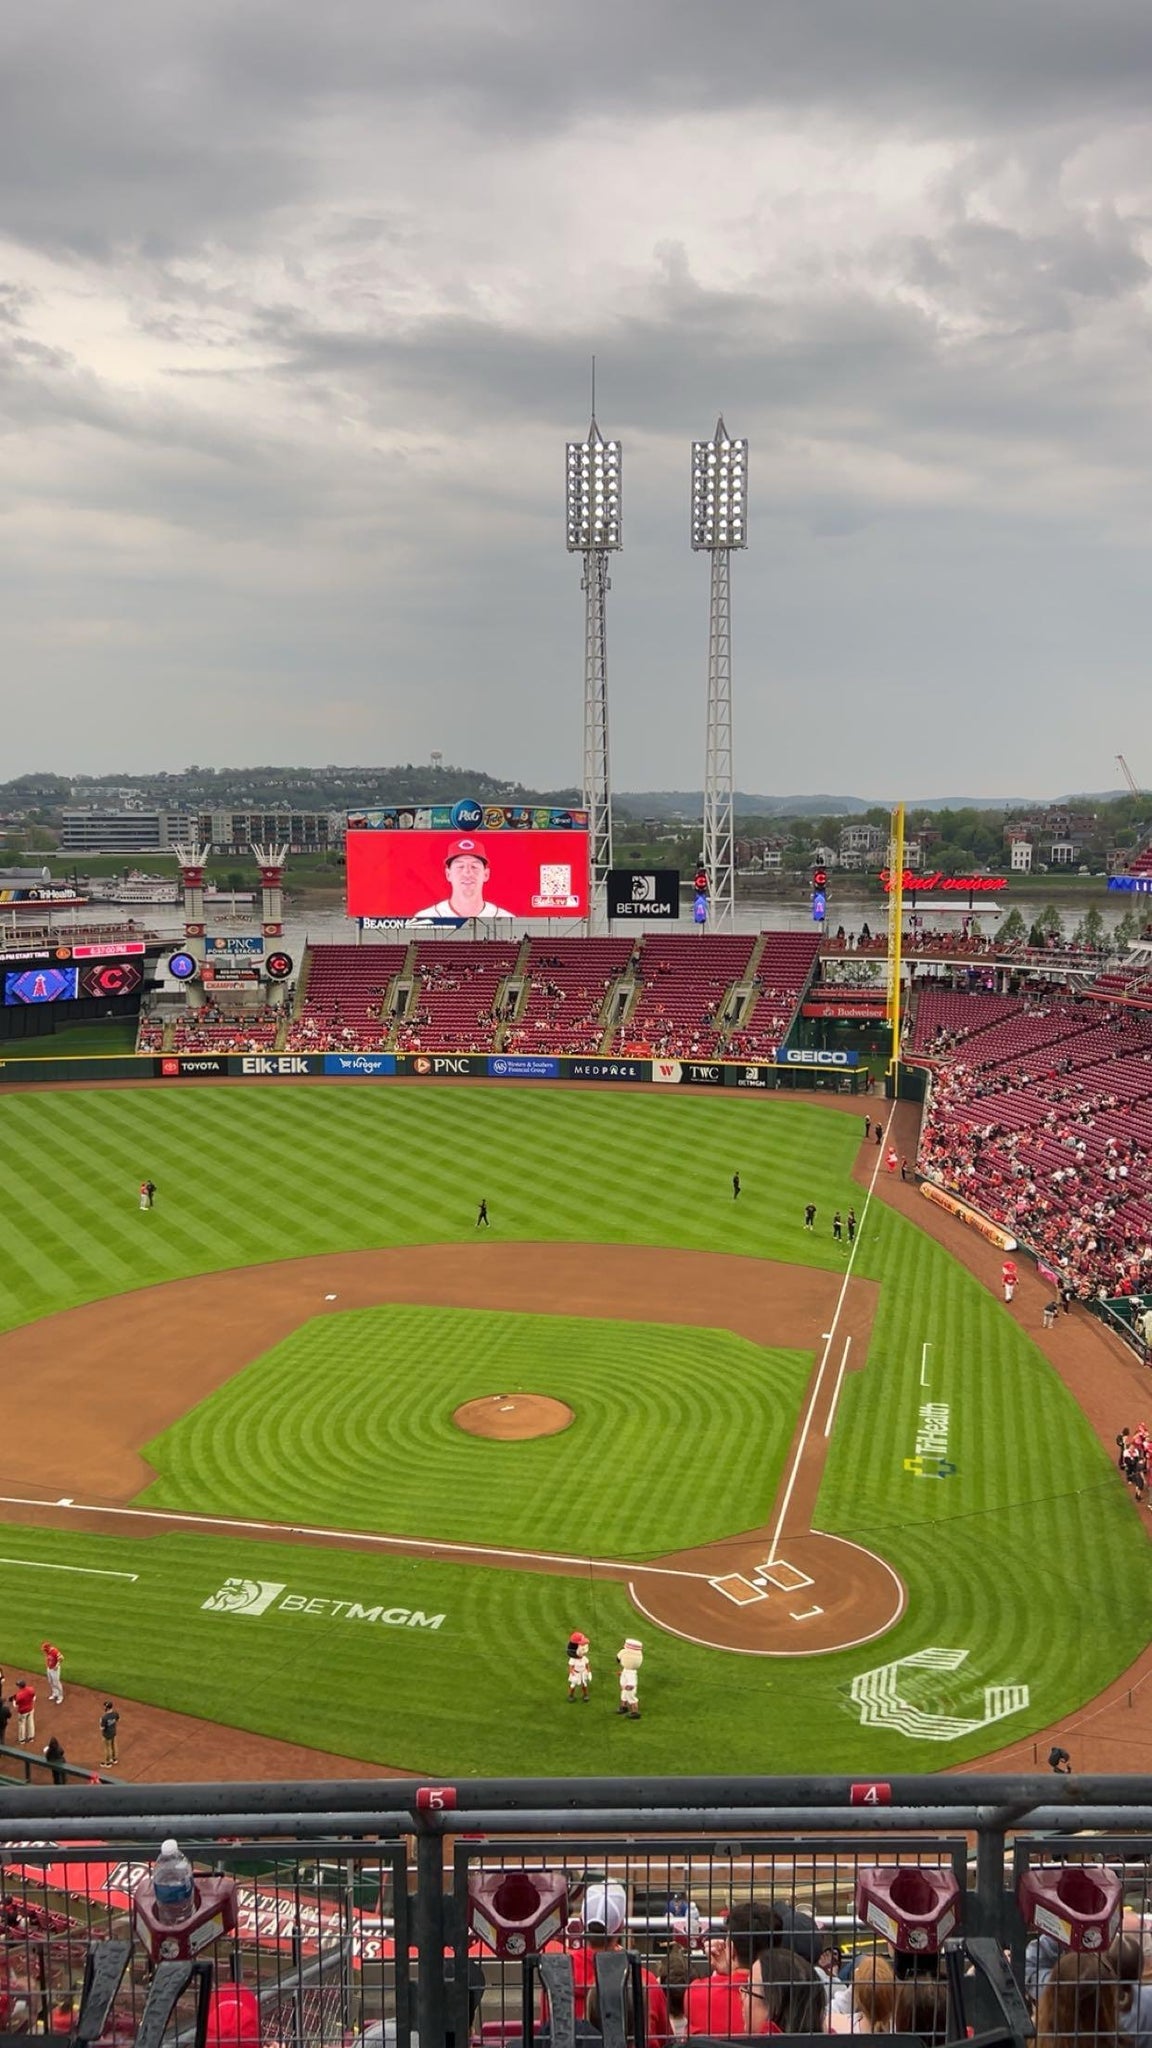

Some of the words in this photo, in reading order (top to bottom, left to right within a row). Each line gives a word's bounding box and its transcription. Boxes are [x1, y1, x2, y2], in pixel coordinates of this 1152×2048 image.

[458, 810, 480, 822] P&G
[38, 889, 77, 899] TriHealth
[616, 902, 671, 914] BETMGM
[363, 917, 404, 929] BEACON
[228, 939, 254, 949] PNC
[837, 1007, 883, 1018] Budweiser
[786, 1050, 848, 1064] GEICO
[182, 1062, 220, 1071] TOYOTA
[242, 1057, 309, 1075] Elk+Elk
[352, 1057, 382, 1074] Kroger
[433, 1059, 470, 1074] PNC
[574, 1064, 637, 1076] MEDPACE
[689, 1065, 719, 1080] TWC
[738, 1079, 766, 1087] BETMGM
[915, 1402, 949, 1454] TriHealth
[278, 1594, 447, 1630] BETMGM
[429, 1791, 444, 1809] 5
[864, 1786, 880, 1805] 4
